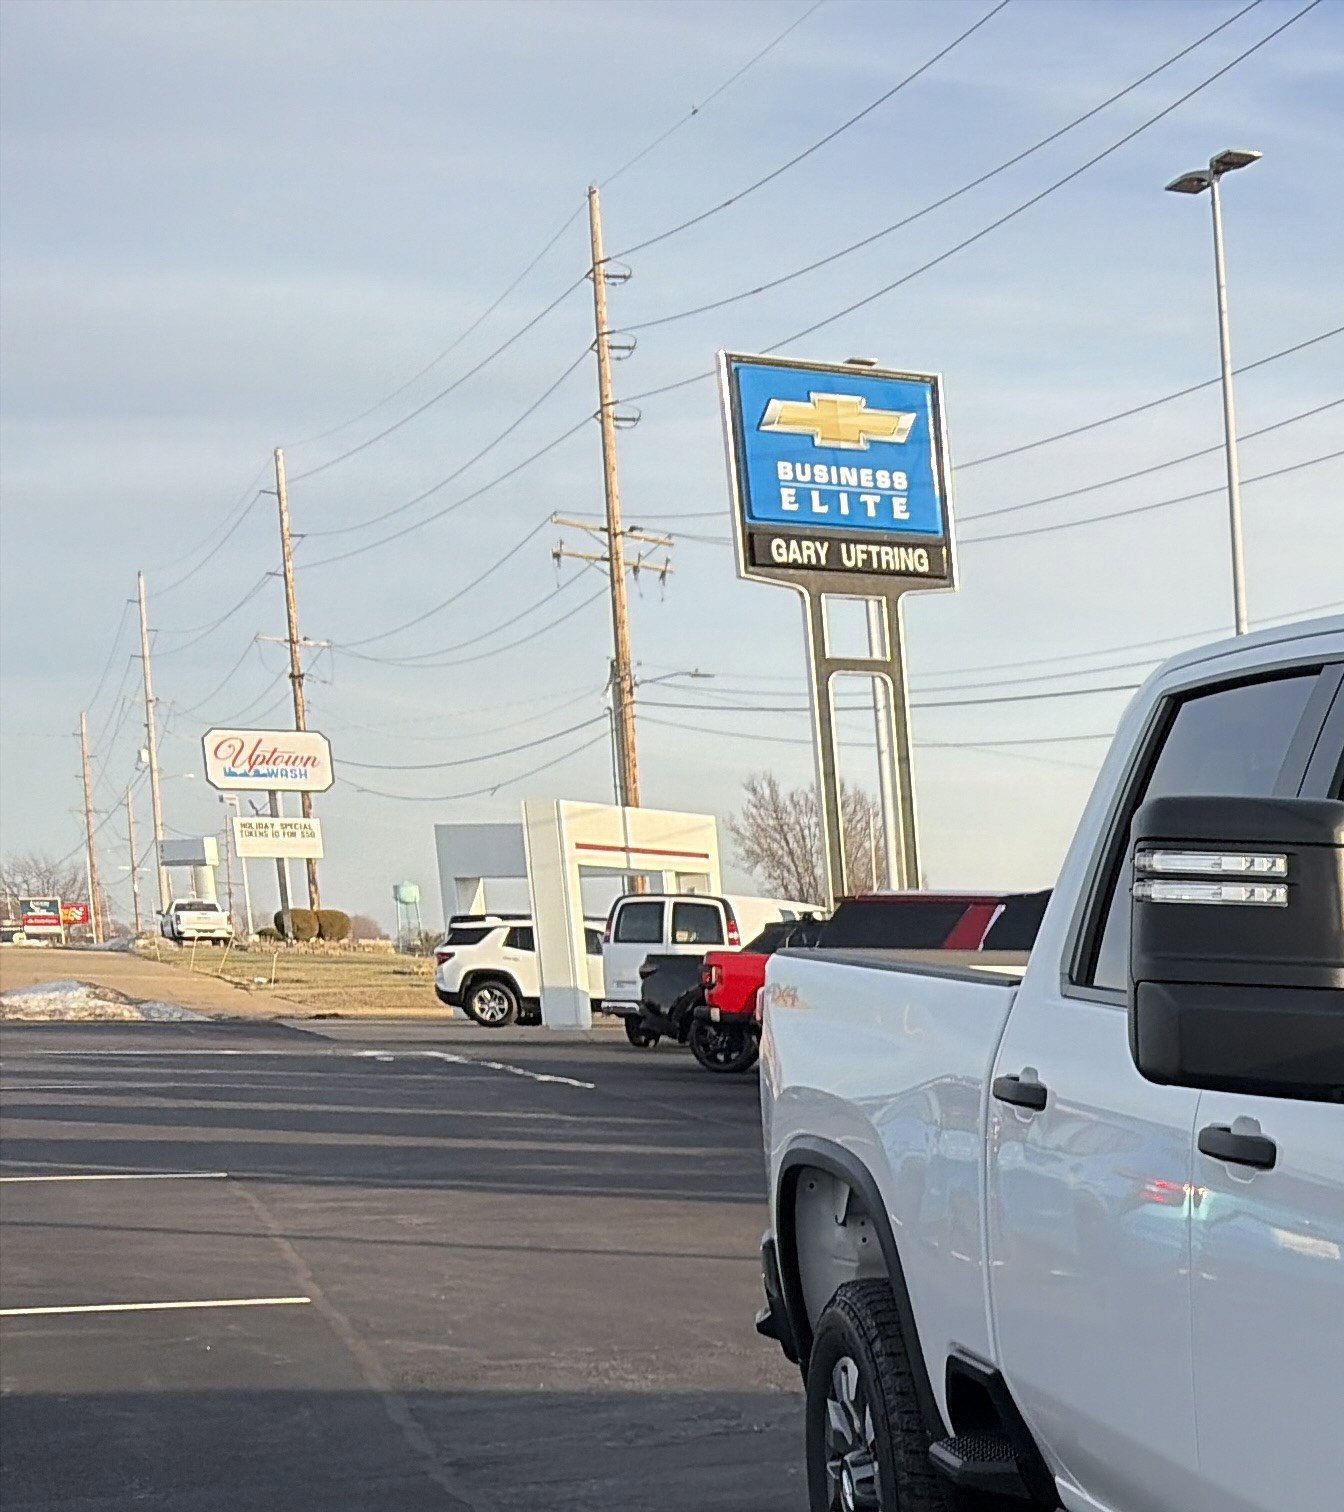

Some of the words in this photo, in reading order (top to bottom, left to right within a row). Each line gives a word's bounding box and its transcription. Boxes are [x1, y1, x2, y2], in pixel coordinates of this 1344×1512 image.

[777, 461, 909, 490] BUSINESS
[780, 488, 911, 520] ELITE
[771, 538, 829, 566] GARY
[841, 543, 930, 573] UFTRING
[214, 737, 319, 773] Uptown
[267, 768, 308, 779] WASH
[240, 822, 274, 830] HOLIDAY
[280, 822, 313, 830] SPECIAL
